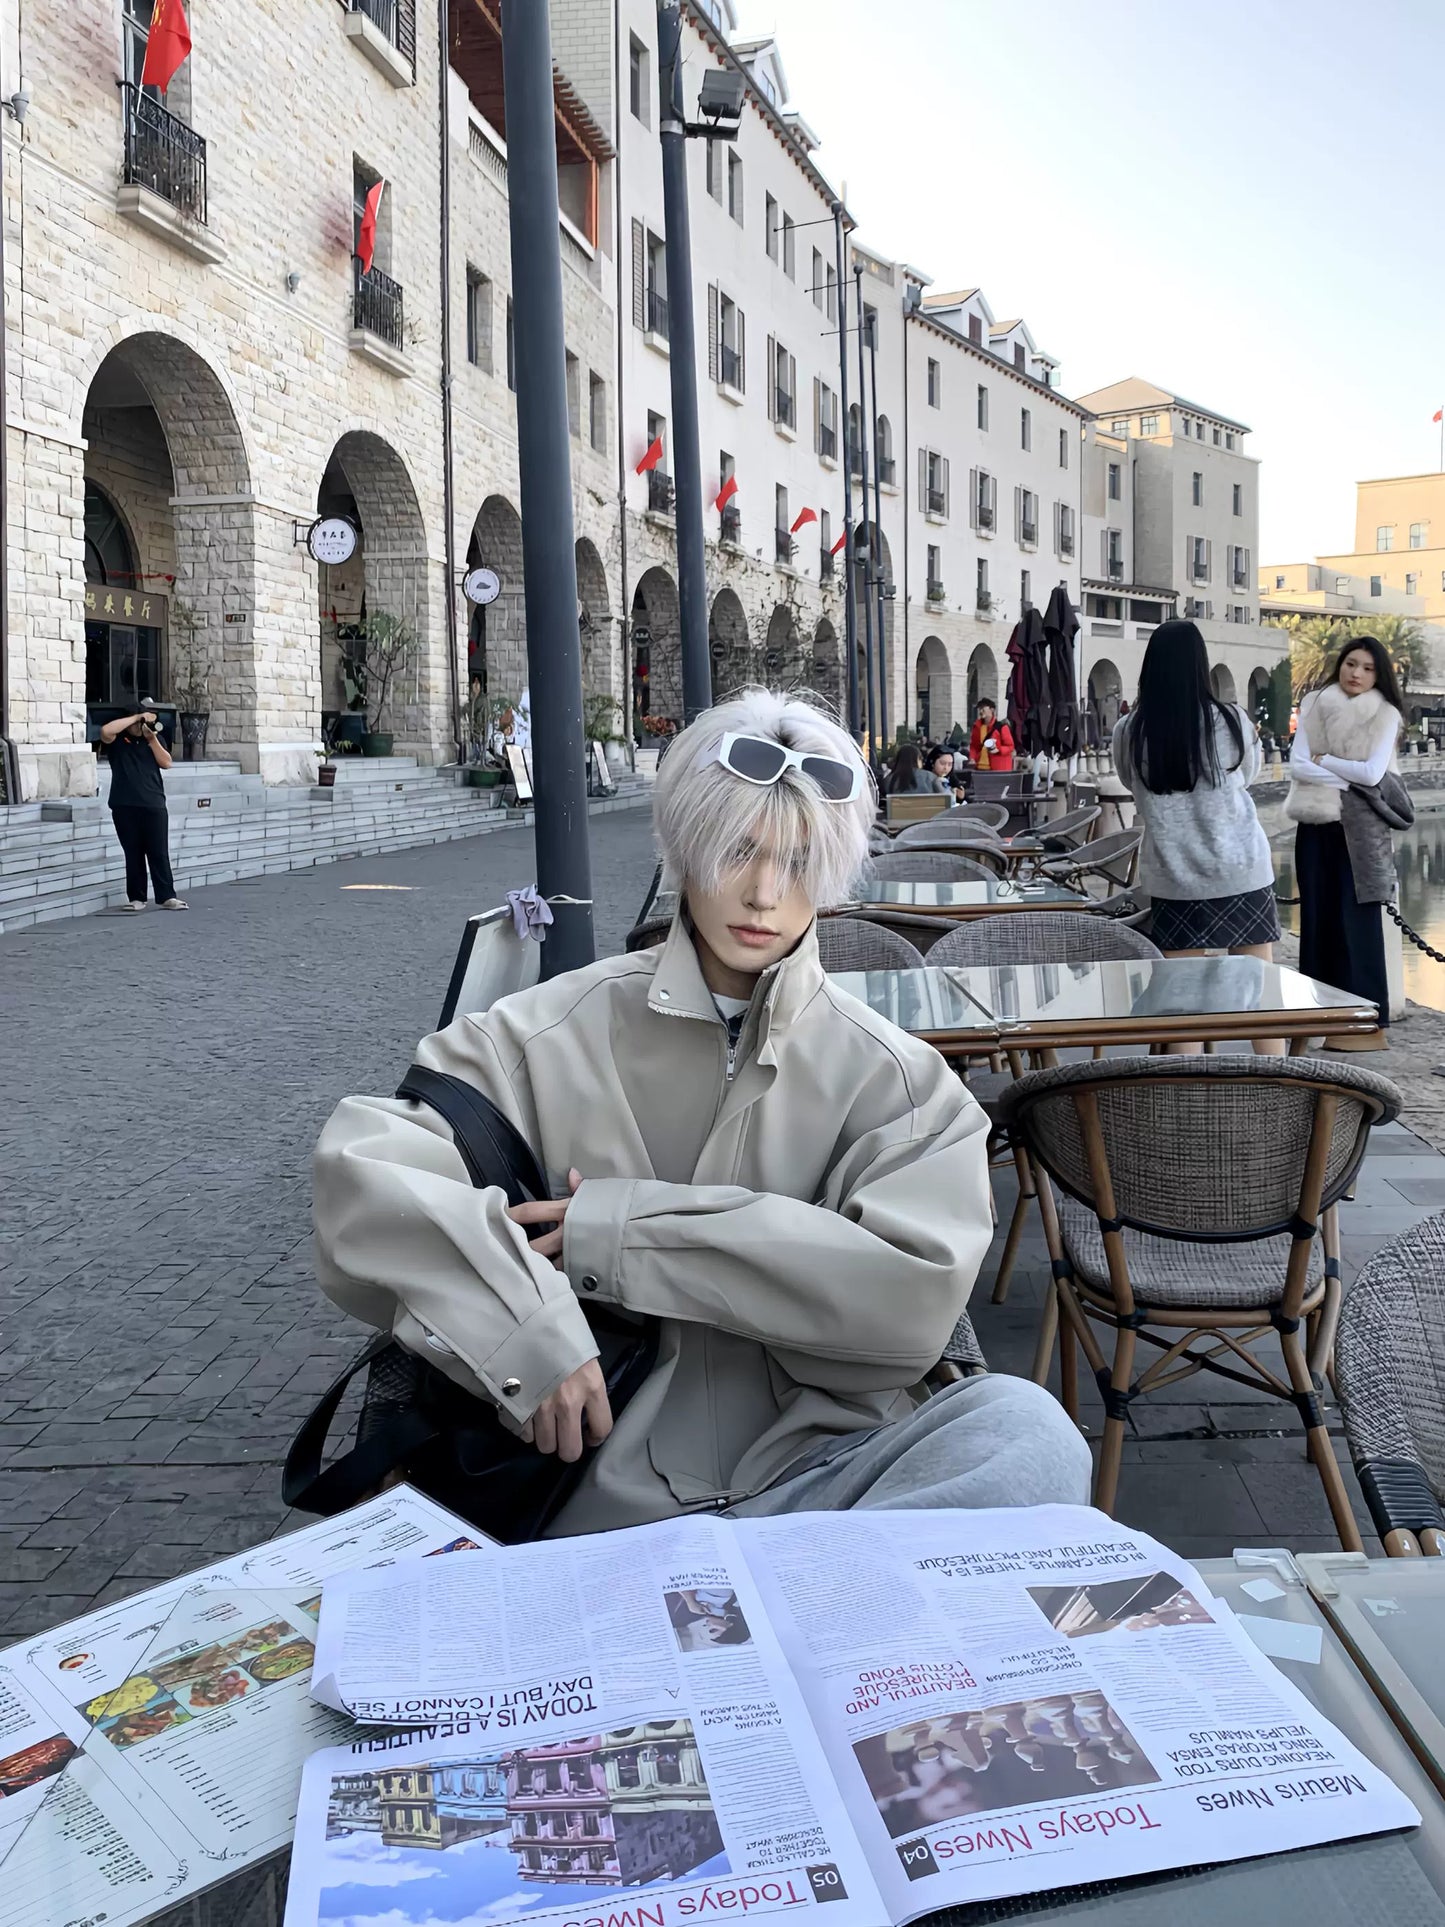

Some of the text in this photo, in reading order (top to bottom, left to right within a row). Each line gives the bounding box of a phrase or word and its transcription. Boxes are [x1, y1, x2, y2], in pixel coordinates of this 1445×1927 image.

[913, 1542, 1137, 1570] BEAUTIFUL AND PICTURESQUE
[940, 1568, 953, 1578] A
[955, 1567, 971, 1577] IS
[975, 1561, 1024, 1576] THERE
[852, 1668, 971, 1698] PICTURESQUE
[858, 1666, 904, 1682] POND
[548, 1676, 593, 1696] DAY,
[664, 1687, 680, 1699] A
[392, 1698, 483, 1713] CANNOT
[490, 1696, 494, 1708] I
[501, 1687, 543, 1706] BUT
[845, 1678, 977, 1715] BEAUTIFUL AND
[523, 1693, 597, 1724] TODAY
[476, 1712, 491, 1730] A
[497, 1709, 516, 1728] IS
[1189, 1725, 1312, 1744] VELIPS NAMLUS
[1166, 1747, 1214, 1762] EMSA
[1175, 1761, 1213, 1777] TODI
[1197, 1774, 1367, 1812] Mauris Nwes
[934, 1804, 1161, 1859] Todays Nwes
[903, 1845, 928, 1865] 04
[813, 1870, 838, 1886] 05
[678, 1880, 807, 1916] Todays
